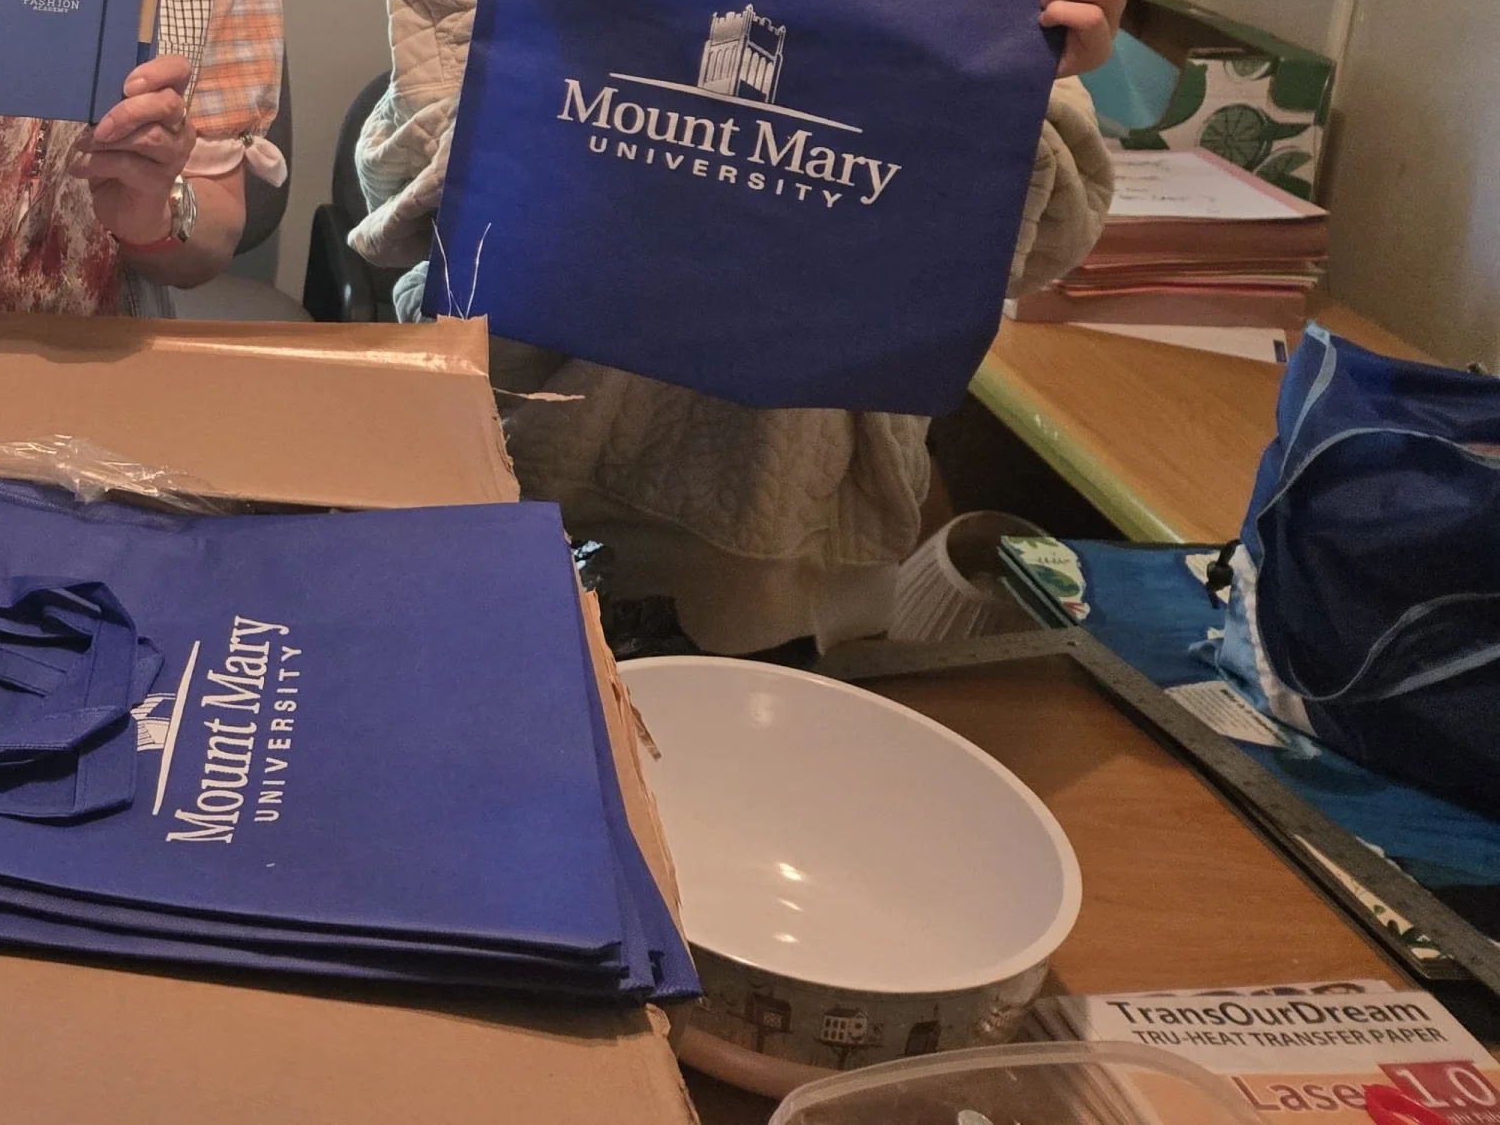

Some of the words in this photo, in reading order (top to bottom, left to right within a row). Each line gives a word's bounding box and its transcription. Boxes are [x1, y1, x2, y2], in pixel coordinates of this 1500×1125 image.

[32, 5, 69, 13] ACADEMY
[557, 78, 740, 156] Mount
[747, 119, 902, 205] Mary
[589, 135, 843, 208] UNIVERSITY
[201, 615, 290, 714] Mary
[254, 645, 302, 822] UNIVERSITY
[165, 718, 258, 844] Mount
[1105, 1000, 1431, 1026] TransOurDream
[1132, 1029, 1254, 1047] TRU-HEAT
[1249, 1029, 1373, 1048] TRANSFER
[1370, 1027, 1449, 1045] PAPER
[1231, 1074, 1367, 1113] Lase
[1394, 1064, 1497, 1108] 1.0
